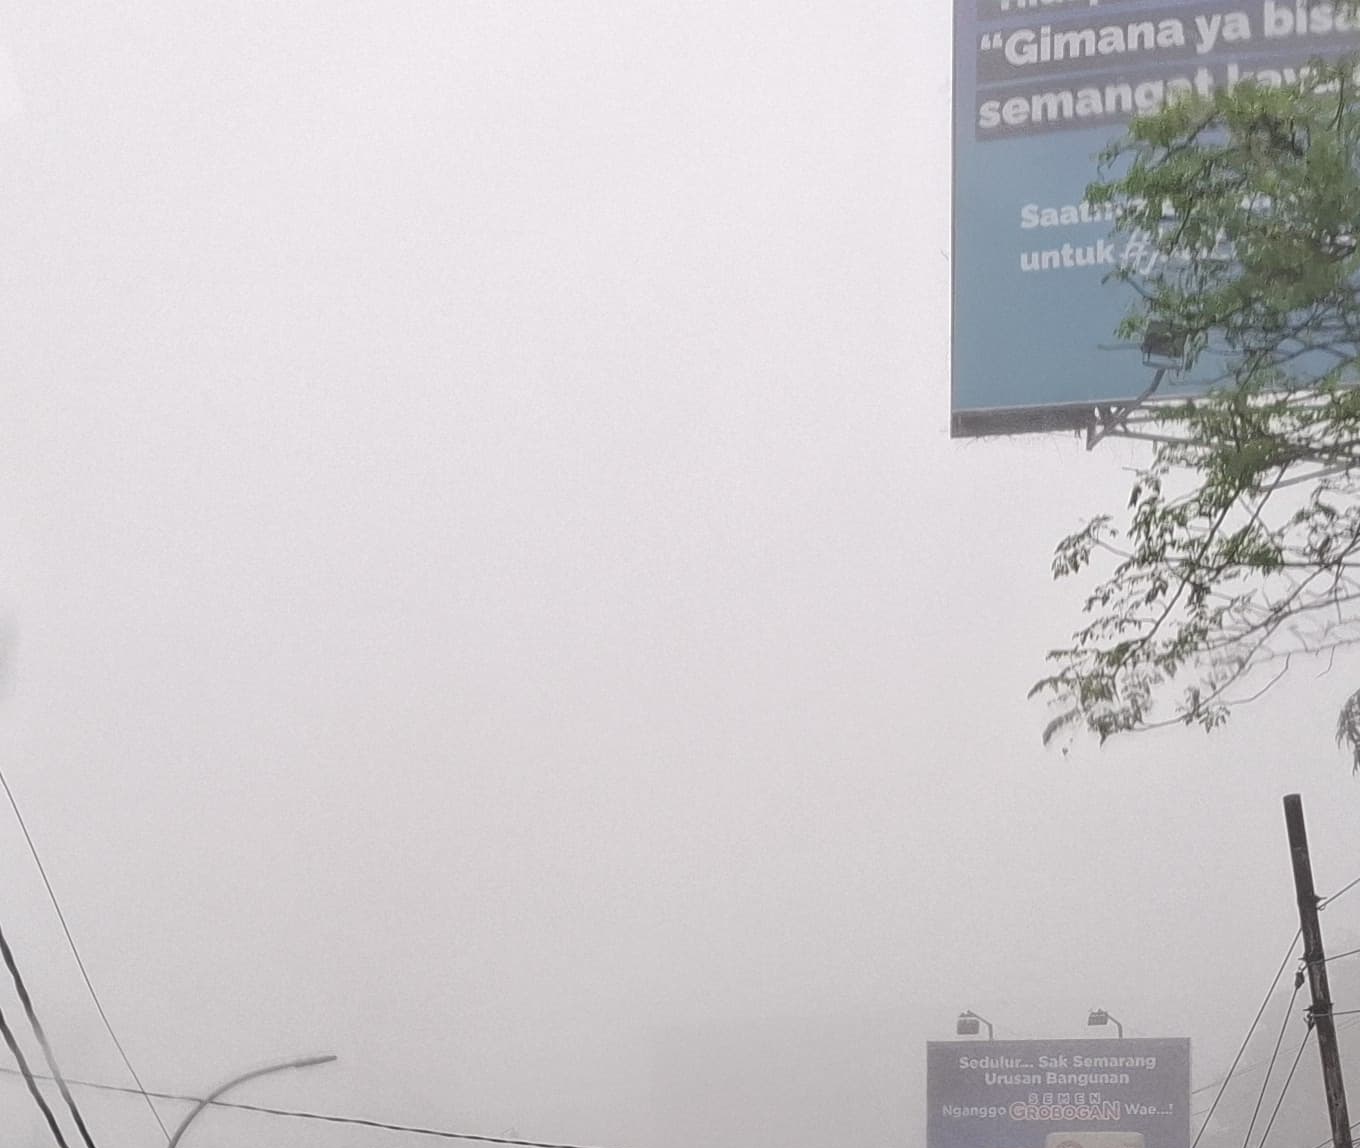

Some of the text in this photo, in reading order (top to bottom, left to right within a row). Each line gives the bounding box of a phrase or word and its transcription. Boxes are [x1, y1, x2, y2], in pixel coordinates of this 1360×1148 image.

[1195, 11, 1252, 54] ya
[978, 67, 1217, 128] semangat
[1019, 239, 1114, 272] untuk
[1039, 1055, 1068, 1068] Sak
[1073, 1055, 1157, 1070] Semarang
[984, 1071, 1130, 1087] Urusan Bangunan
[942, 1104, 1007, 1118] Nganggo
[1008, 1101, 1120, 1120] GROBOGAN
